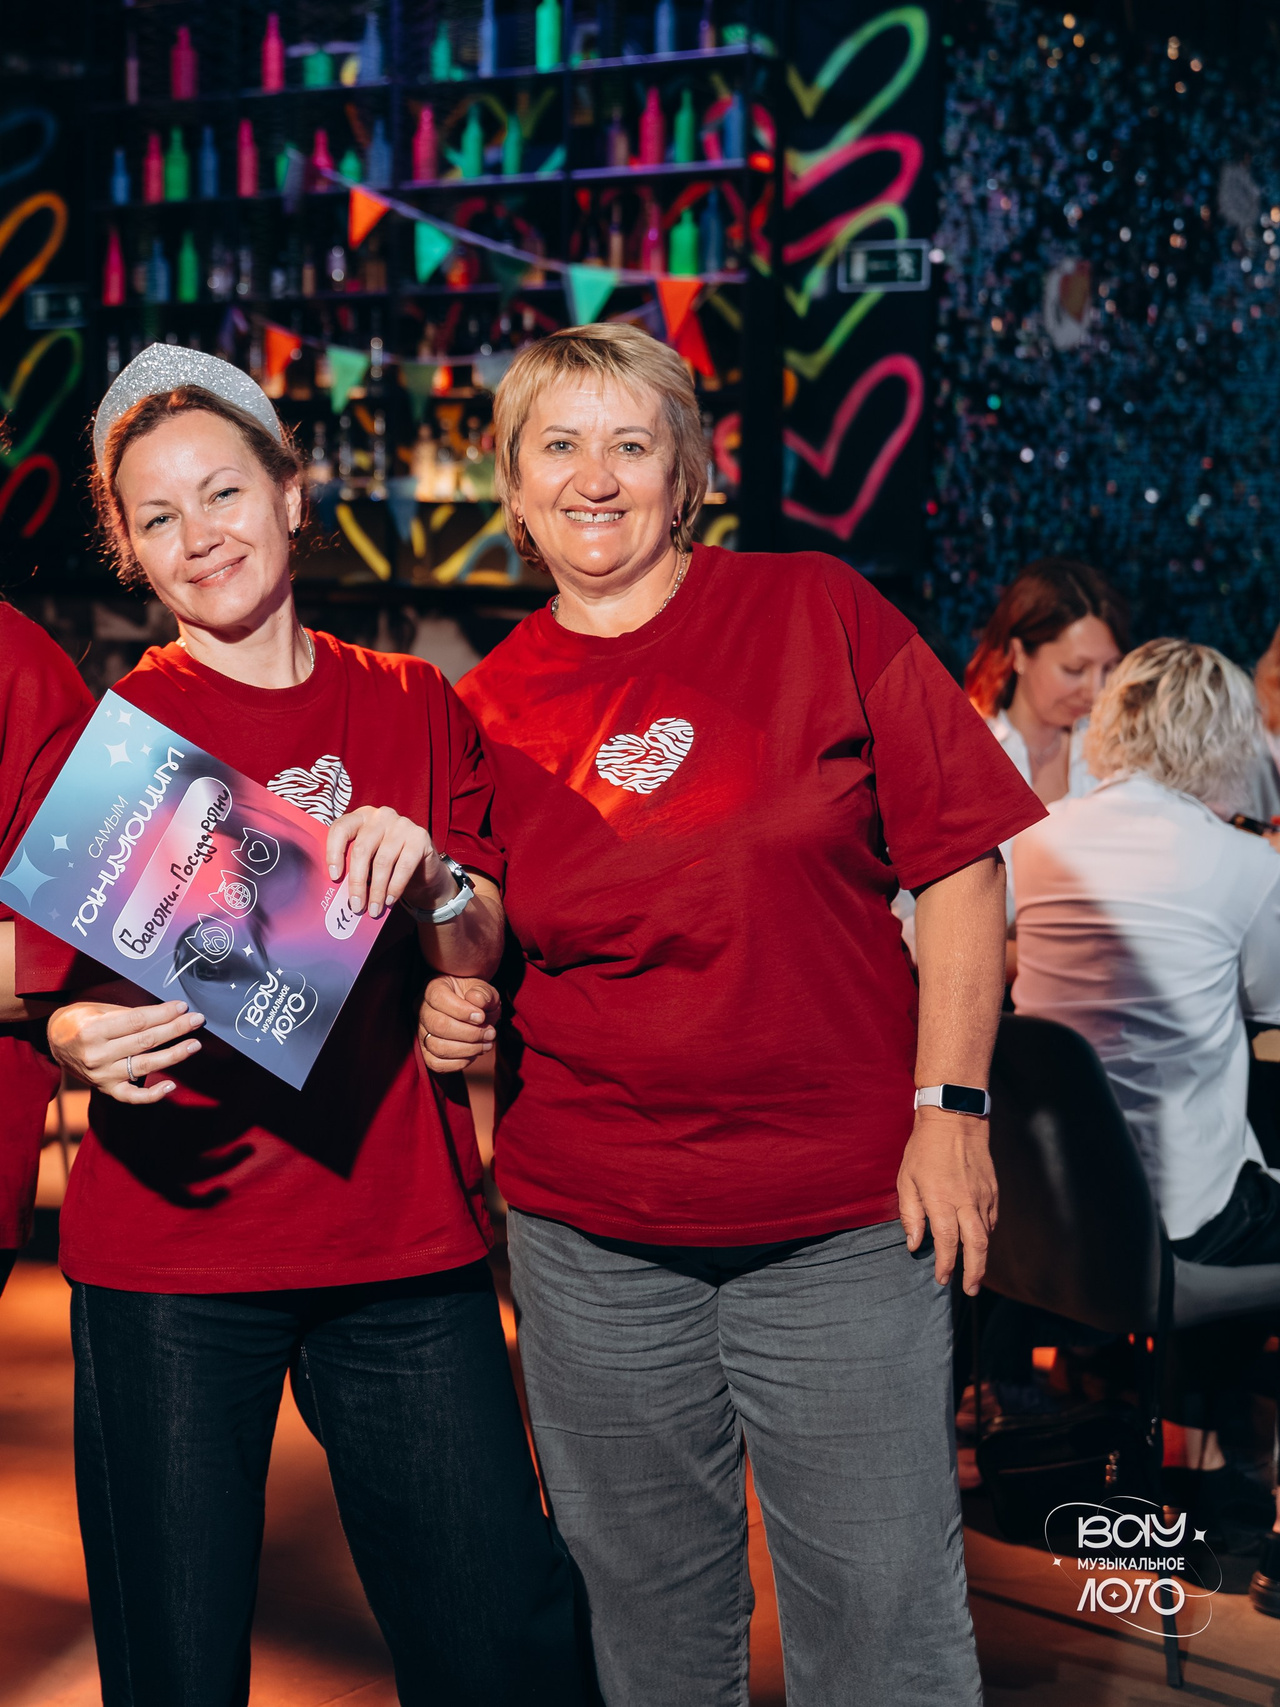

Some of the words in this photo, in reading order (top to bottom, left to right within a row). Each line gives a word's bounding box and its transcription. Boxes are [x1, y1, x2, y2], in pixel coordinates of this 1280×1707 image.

[88, 794, 129, 859] САМЫМ
[320, 887, 336, 911] ДАТА
[244, 970, 279, 1027] ВАУ
[260, 984, 291, 1034] МУЗЫКАЛЬНОЕ
[271, 993, 305, 1045] ЛОТО
